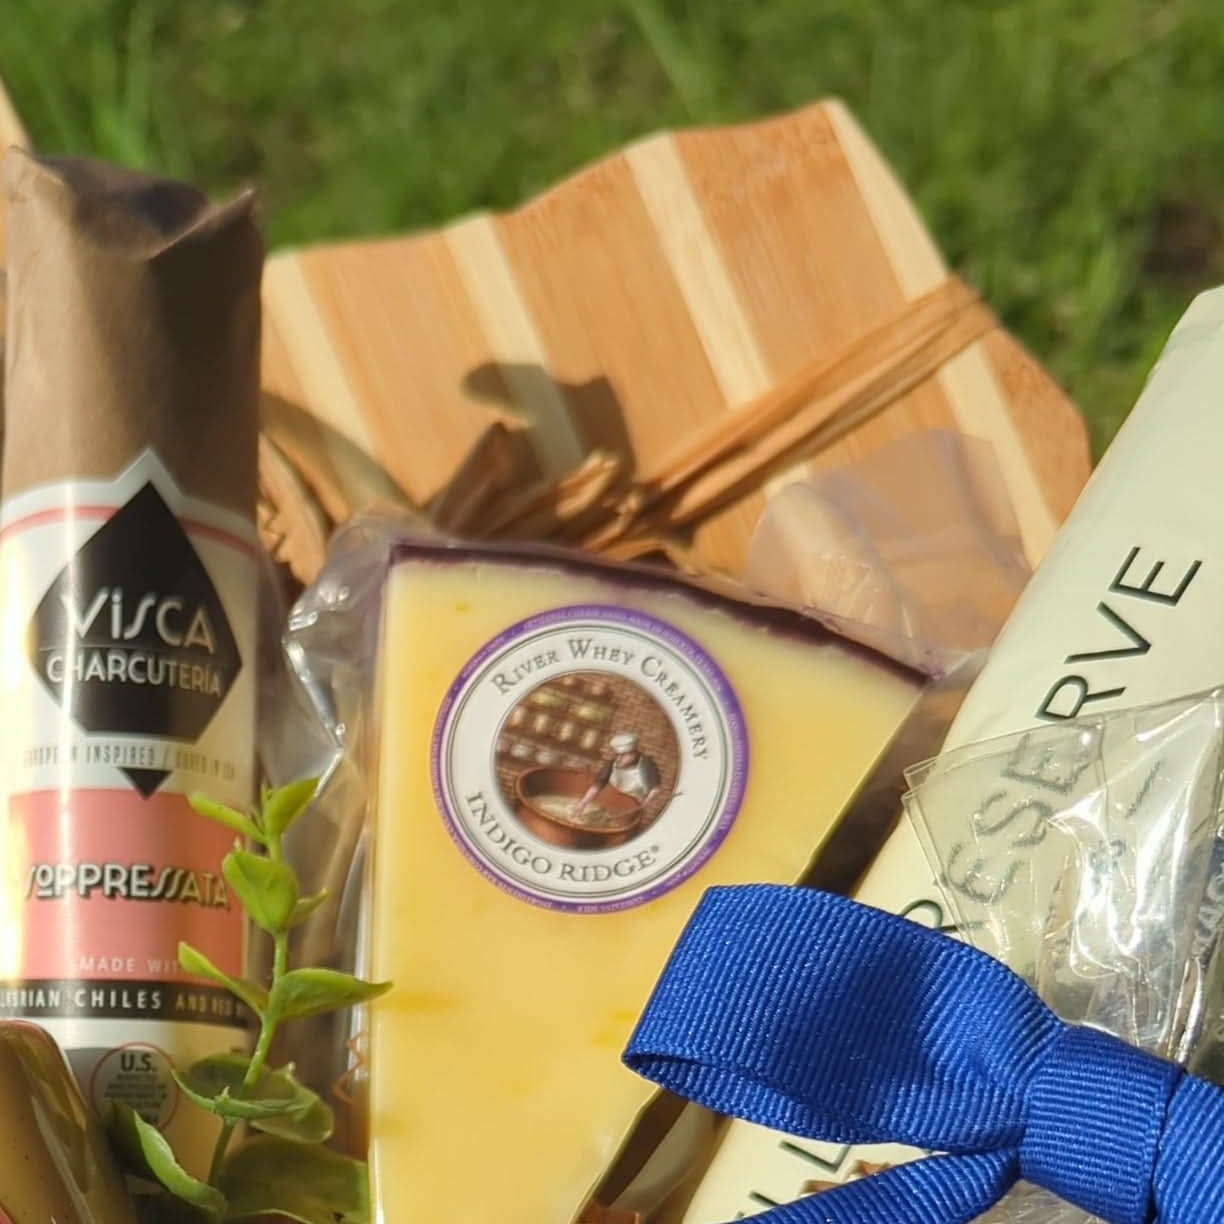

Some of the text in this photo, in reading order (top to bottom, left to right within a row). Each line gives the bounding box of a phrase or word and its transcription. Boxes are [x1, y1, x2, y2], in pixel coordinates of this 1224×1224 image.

[466, 791, 552, 877] INDIGO
[79, 956, 179, 973] MADE WIT
[76, 990, 162, 1009] CHILES
